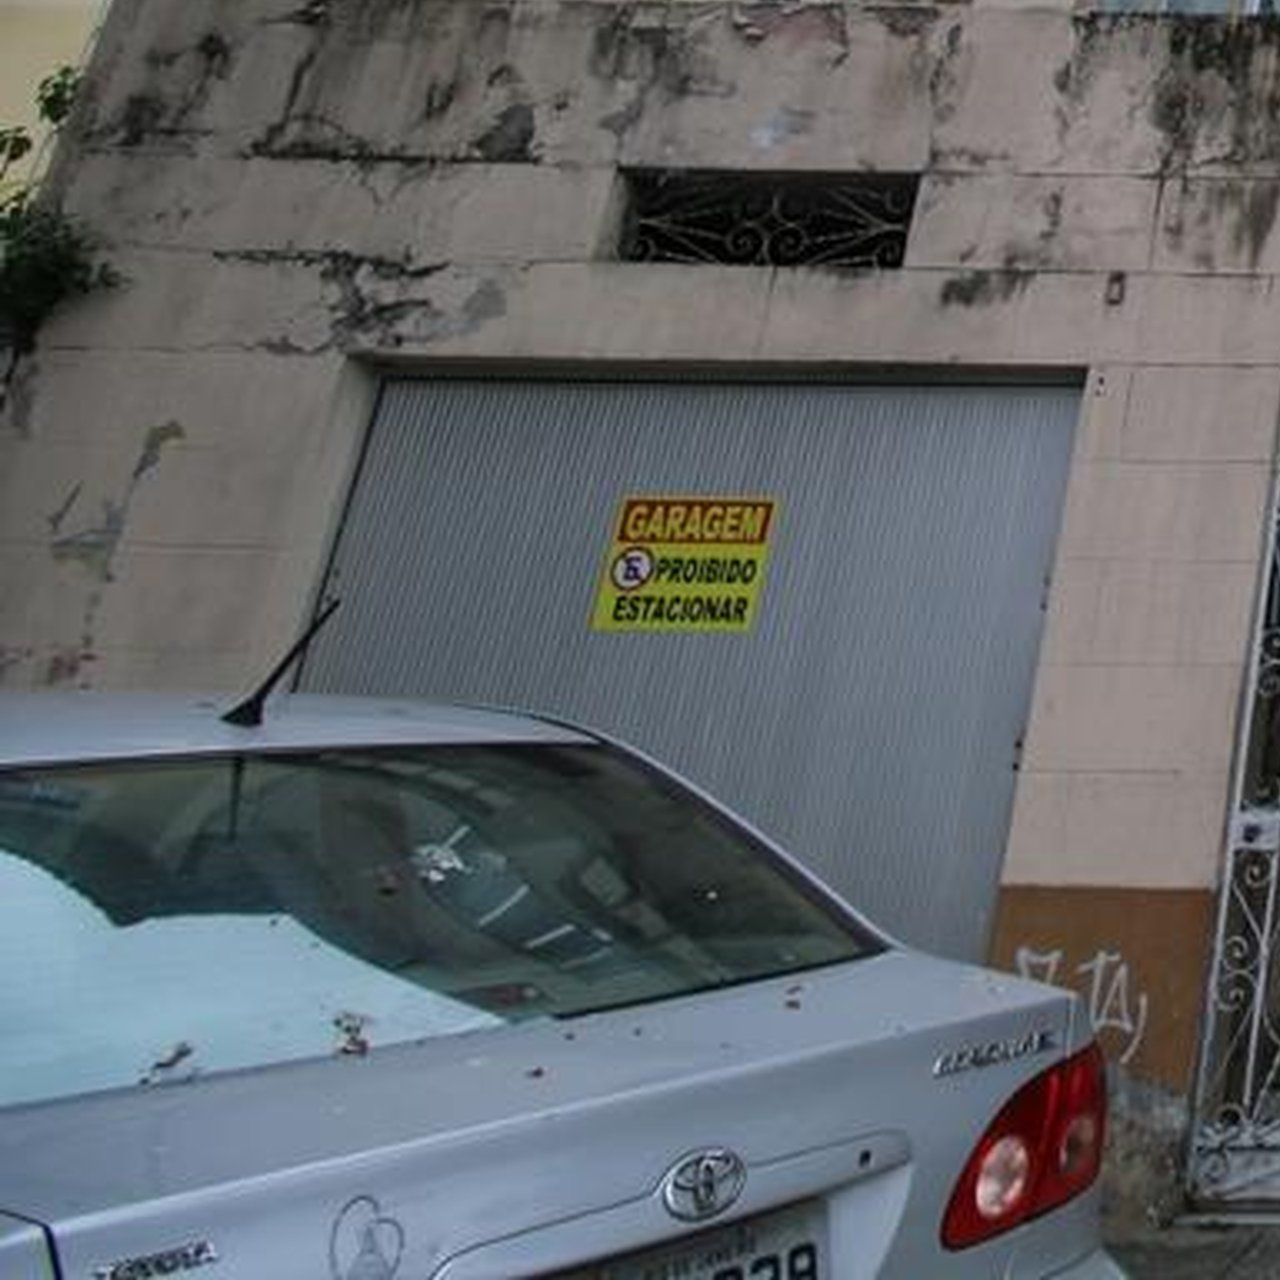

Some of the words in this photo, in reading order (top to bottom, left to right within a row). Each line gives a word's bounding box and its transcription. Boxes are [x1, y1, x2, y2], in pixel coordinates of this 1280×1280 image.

[624, 504, 767, 541] GARAGEM
[654, 558, 757, 584] PROIBIDO
[612, 595, 749, 623] ESTACIONAR
